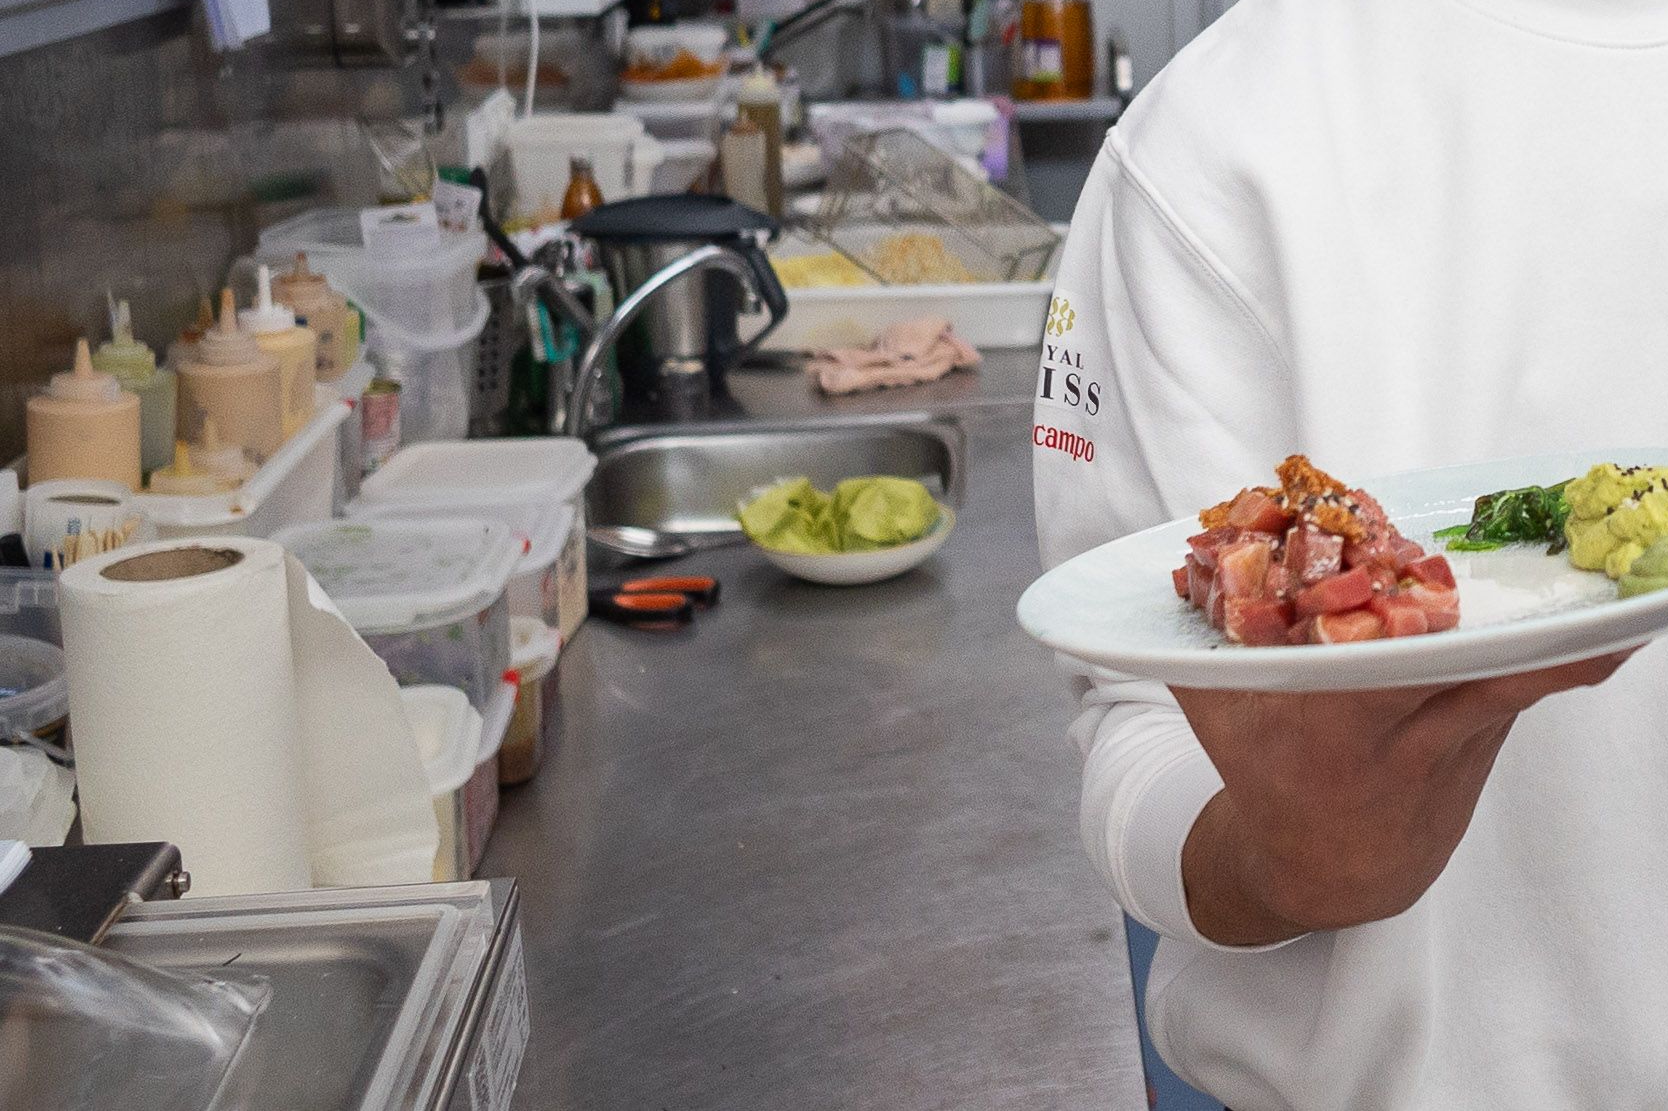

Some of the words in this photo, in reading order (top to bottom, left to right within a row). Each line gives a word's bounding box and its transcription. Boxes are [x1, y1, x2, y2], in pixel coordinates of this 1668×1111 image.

[1046, 344, 1085, 370] YAL
[1040, 365, 1101, 417] ISS
[1033, 424, 1096, 463] campo
